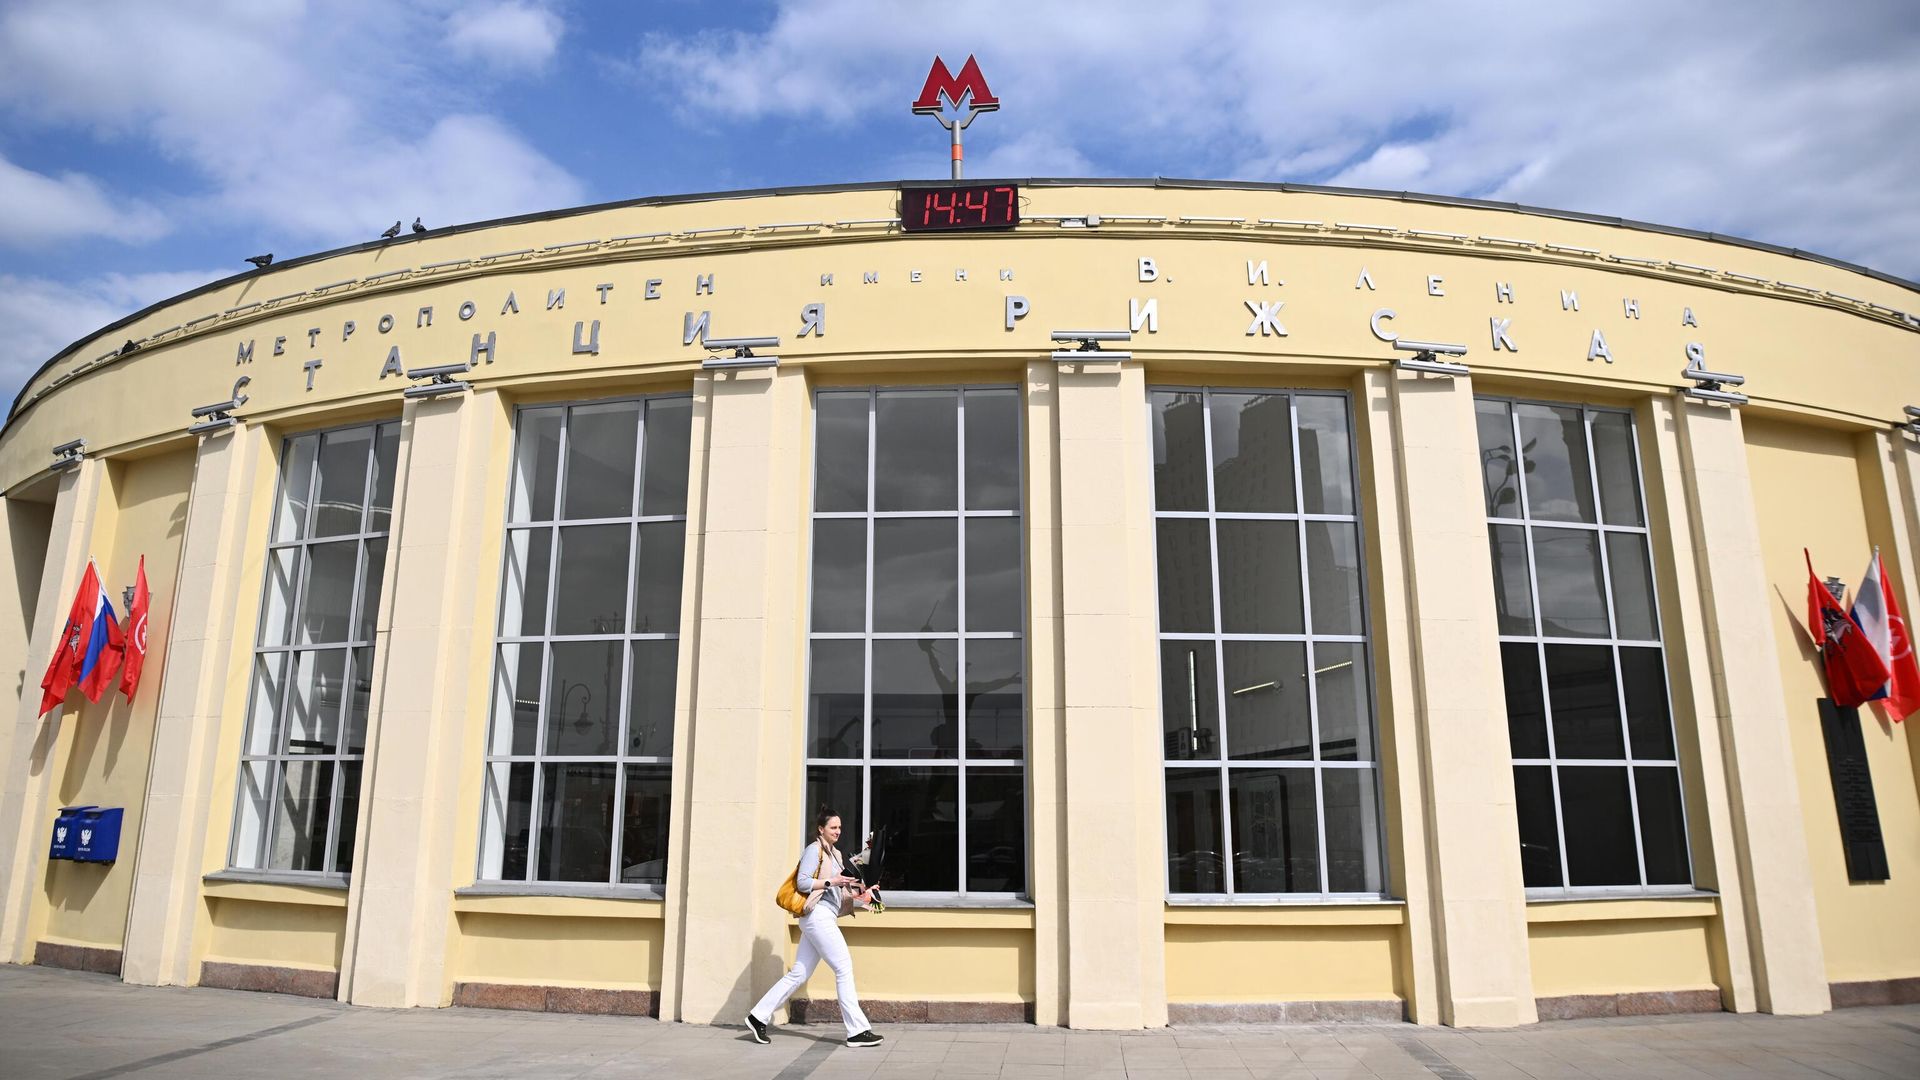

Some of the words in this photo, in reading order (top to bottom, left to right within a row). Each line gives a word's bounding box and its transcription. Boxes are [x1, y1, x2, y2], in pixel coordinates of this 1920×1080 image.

[923, 187, 1015, 225] 14:47
[232, 302, 826, 404] СТАНЦИЯ
[1005, 295, 1707, 371] РИЖСКАЯ
[236, 272, 715, 366] МЕТРОПОЛИТЕН
[820, 268, 1014, 286] ИМЕНИ
[1137, 256, 1174, 284] В.
[1247, 259, 1285, 286] И.
[1355, 266, 1698, 329] ЛЕНИНА
